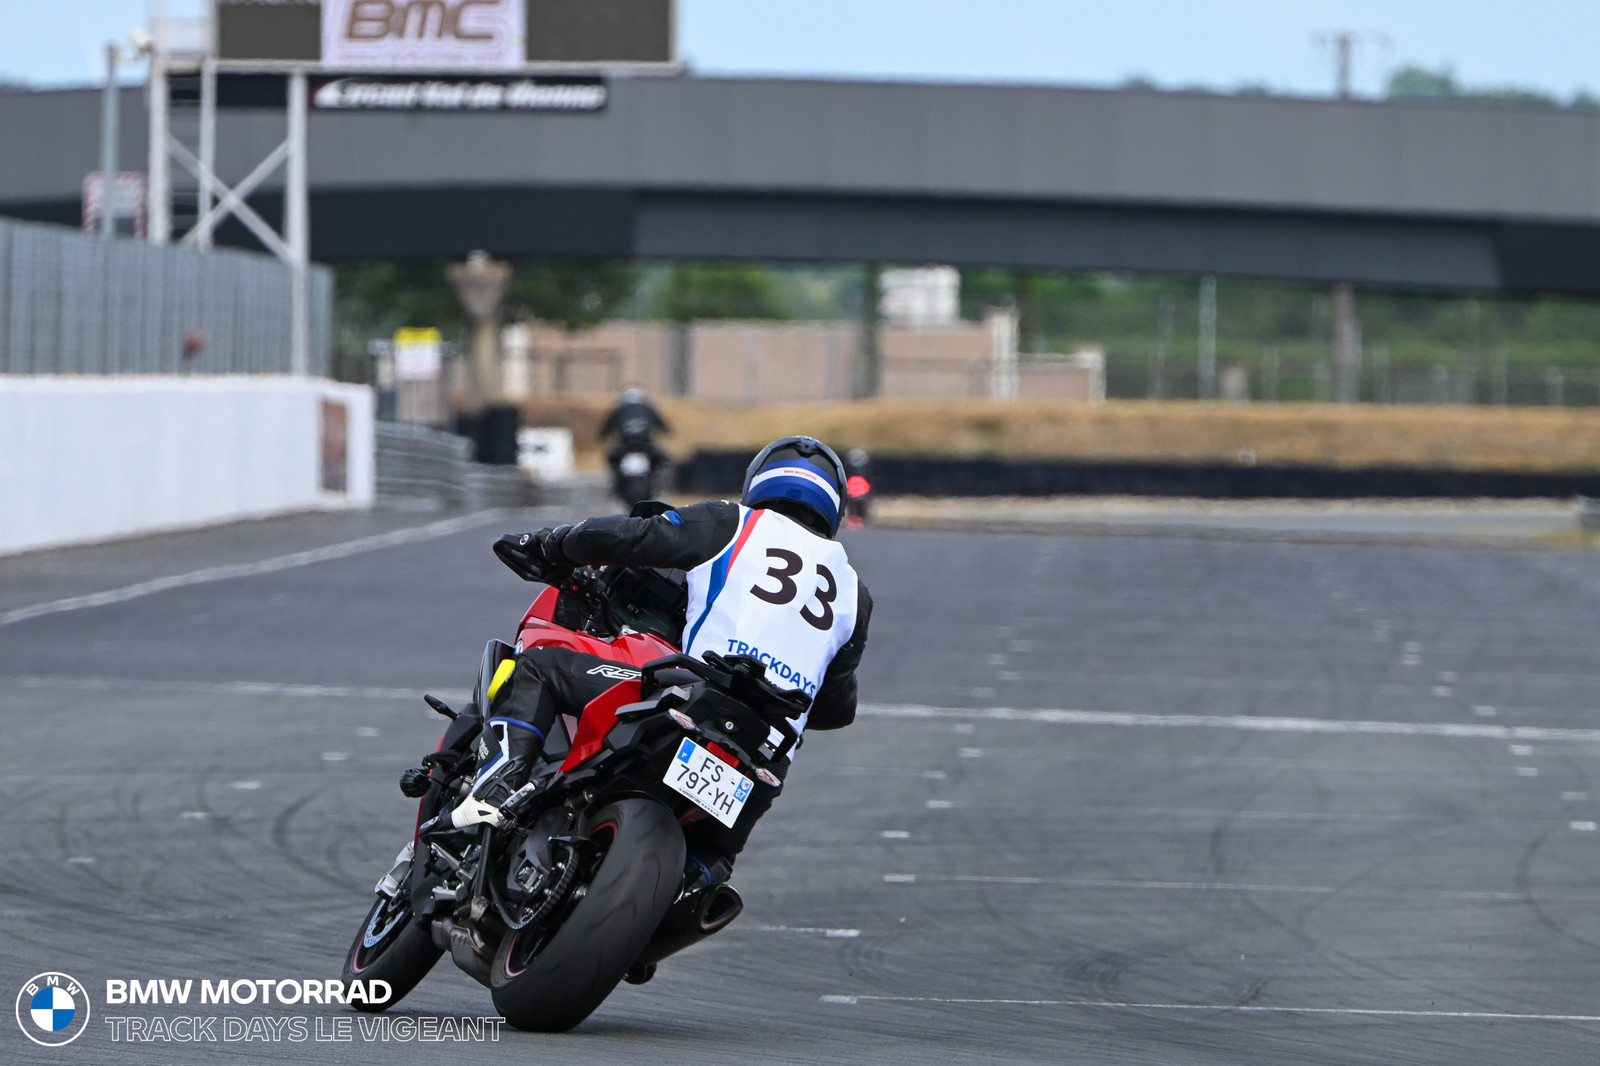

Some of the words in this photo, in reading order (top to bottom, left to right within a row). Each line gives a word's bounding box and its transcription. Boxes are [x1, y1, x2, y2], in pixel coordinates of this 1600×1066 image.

[345, 0, 494, 40] BMC
[750, 548, 837, 631] 33
[586, 664, 642, 680] RS
[727, 639, 816, 698] TRACKDAYS
[677, 763, 735, 815] 797-YH
[700, 757, 724, 783] FS
[735, 788, 747, 801] 87
